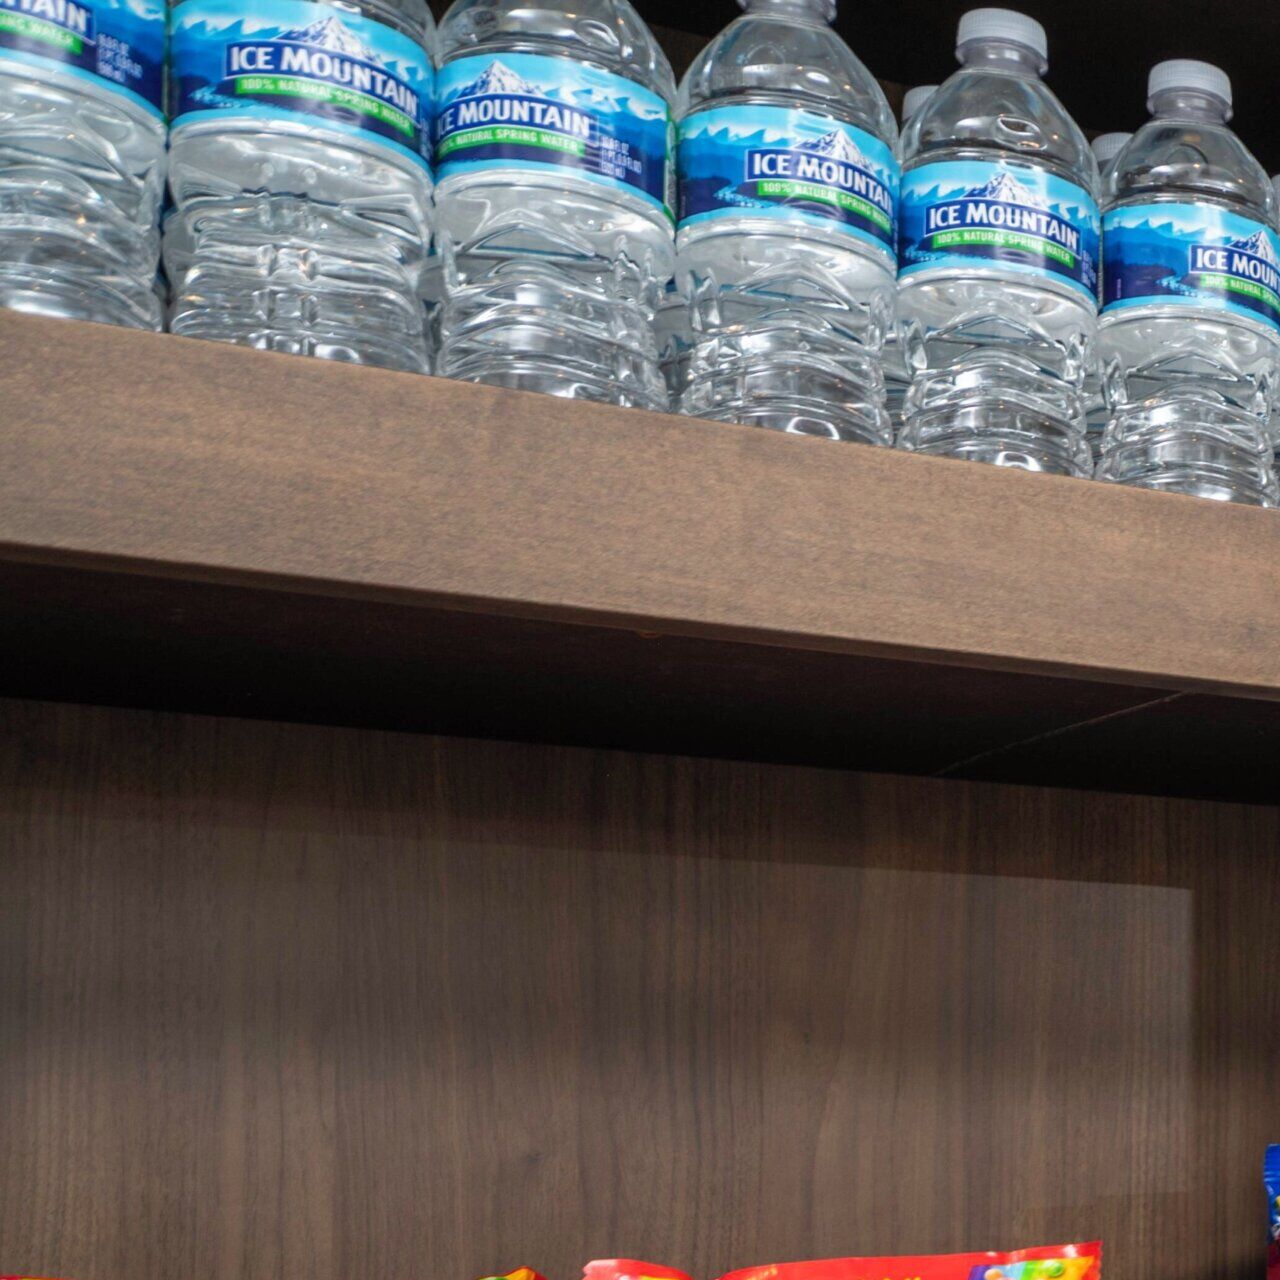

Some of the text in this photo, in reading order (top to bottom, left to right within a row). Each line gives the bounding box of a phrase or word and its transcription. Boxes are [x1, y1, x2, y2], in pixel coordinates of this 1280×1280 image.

[230, 46, 419, 116] ICE MOUNTAIN
[241, 78, 274, 90] 100%
[278, 79, 332, 98] NATURAL
[457, 99, 590, 137] MOUNTAIN
[456, 128, 579, 152] NATURAL SPRING WATER
[753, 153, 793, 176] ICE
[763, 182, 792, 194] 100%
[796, 185, 839, 202] NATURAL
[928, 202, 1078, 251] ICE MOUNTAIN
[937, 231, 1071, 263] 100% NATURAL SPRING WATER
[1195, 247, 1229, 271] ICE
[1230, 278, 1262, 296] NATURAL
